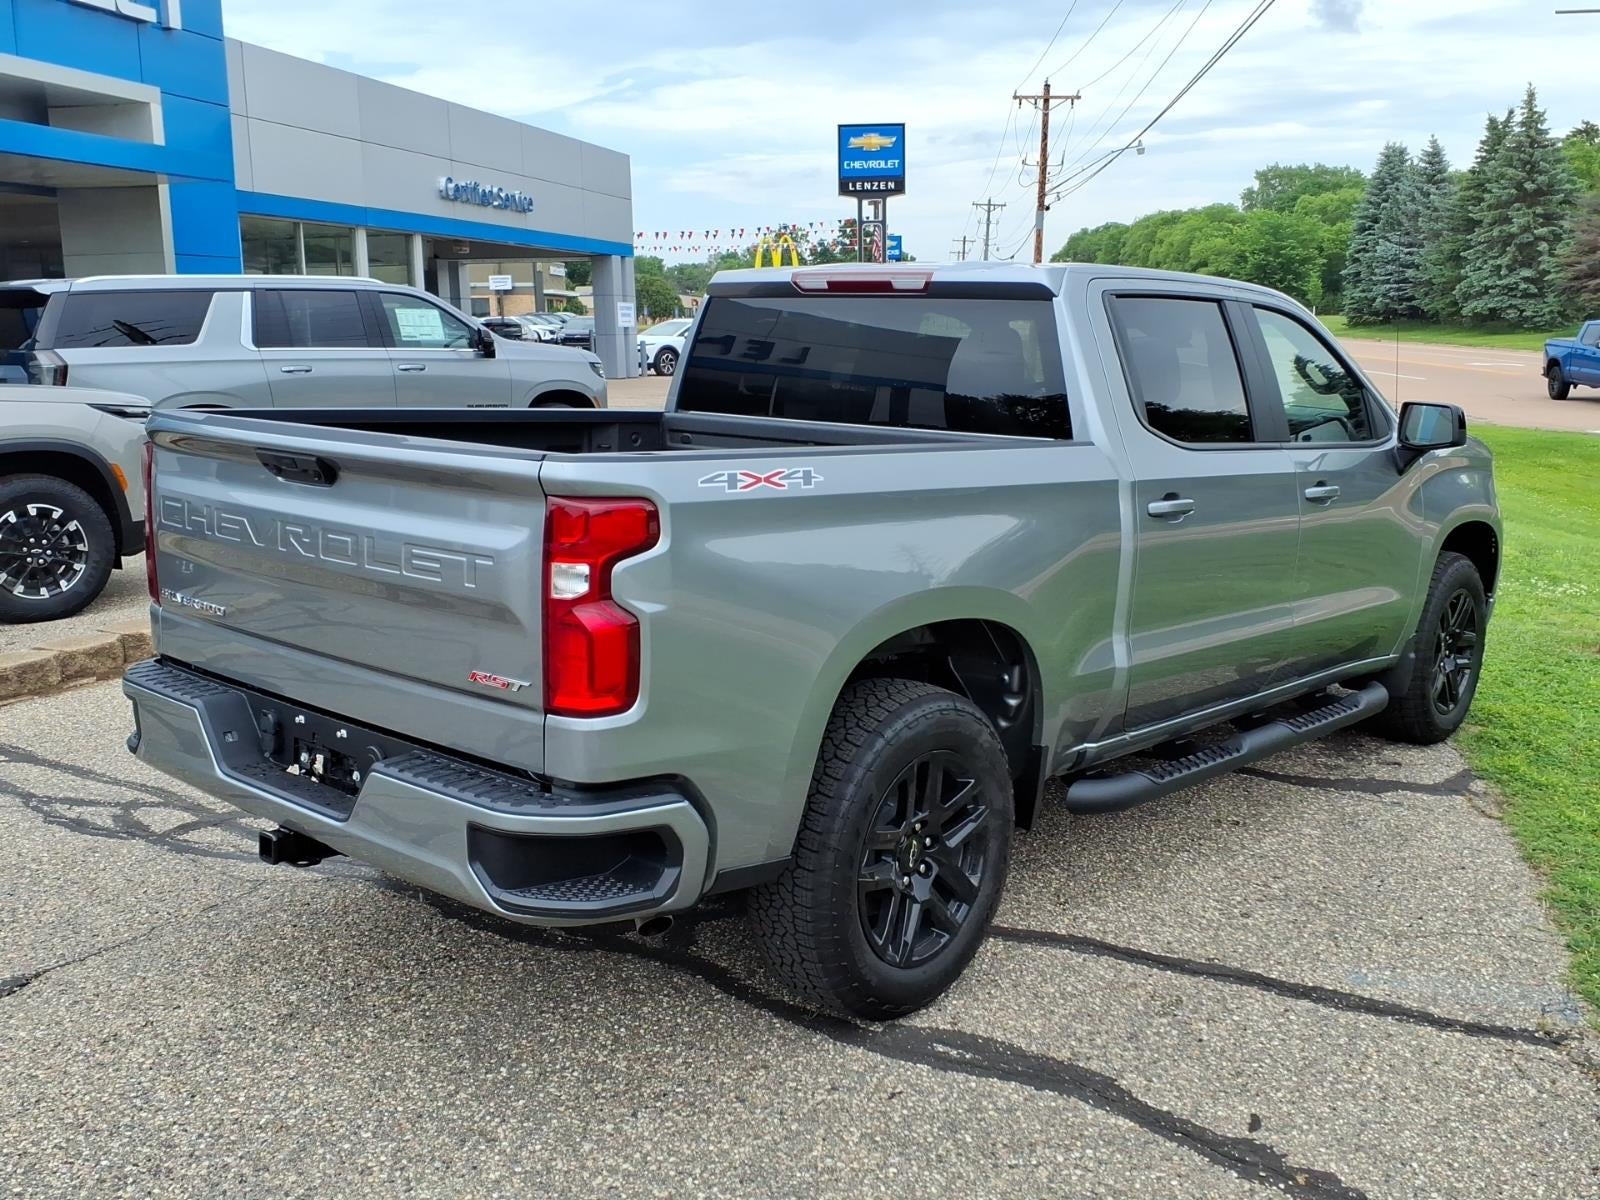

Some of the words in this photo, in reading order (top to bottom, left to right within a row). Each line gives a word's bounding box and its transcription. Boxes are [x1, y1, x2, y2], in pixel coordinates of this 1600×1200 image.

[844, 160, 899, 169] CHEVROLET
[440, 177, 493, 206] Certified
[493, 186, 534, 214] Service
[848, 181, 895, 190] LENZEN
[160, 496, 495, 588] CHEVROLET
[468, 670, 531, 691] RST
